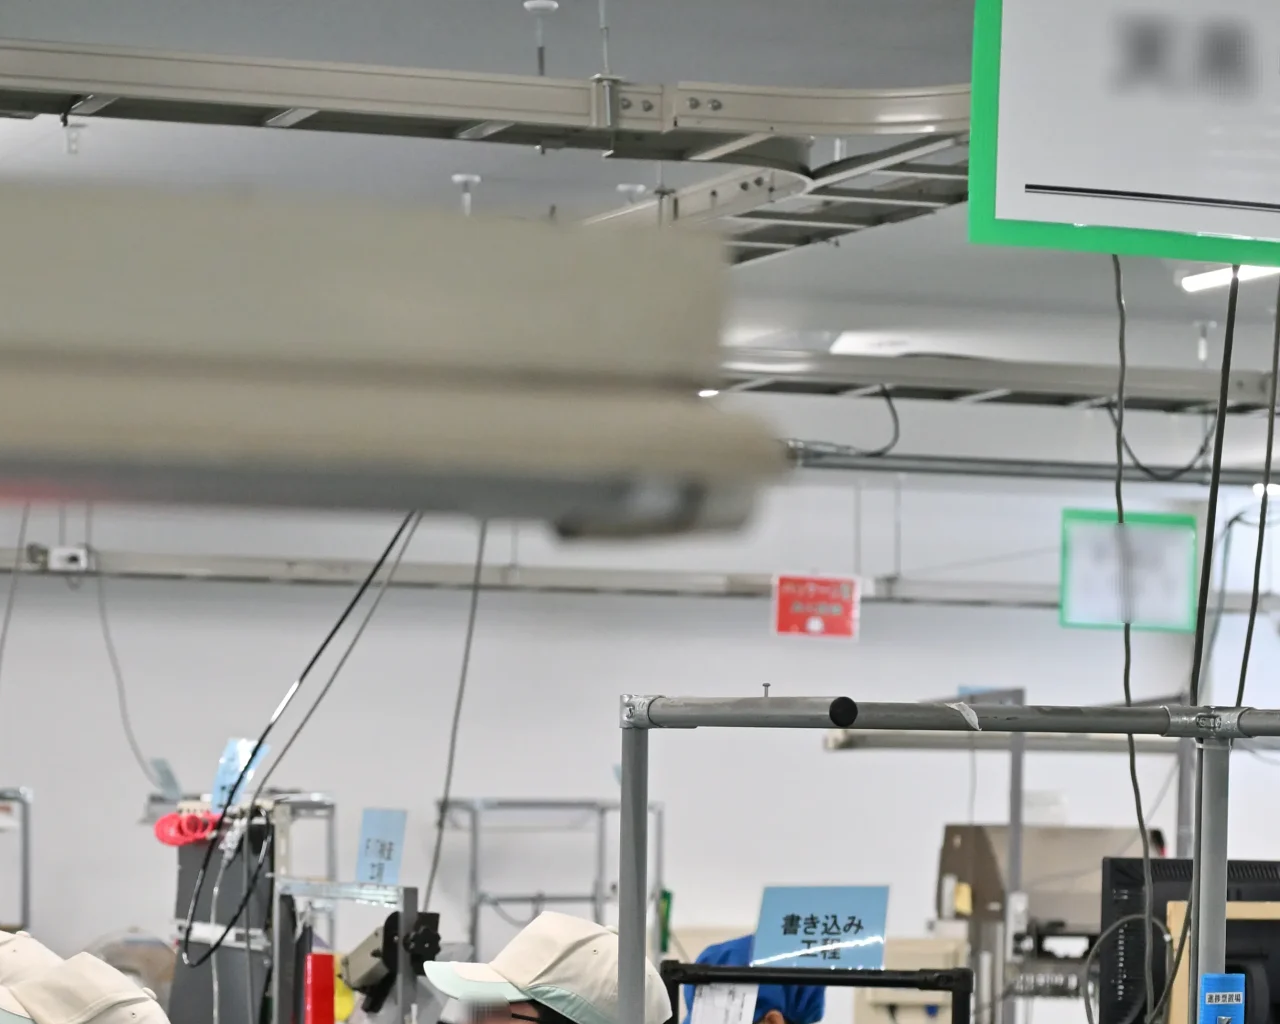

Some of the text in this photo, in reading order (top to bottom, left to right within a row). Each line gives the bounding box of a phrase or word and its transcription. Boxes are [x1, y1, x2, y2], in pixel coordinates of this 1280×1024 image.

[782, 913, 864, 935] 書き込み
[799, 938, 841, 960] 工程
